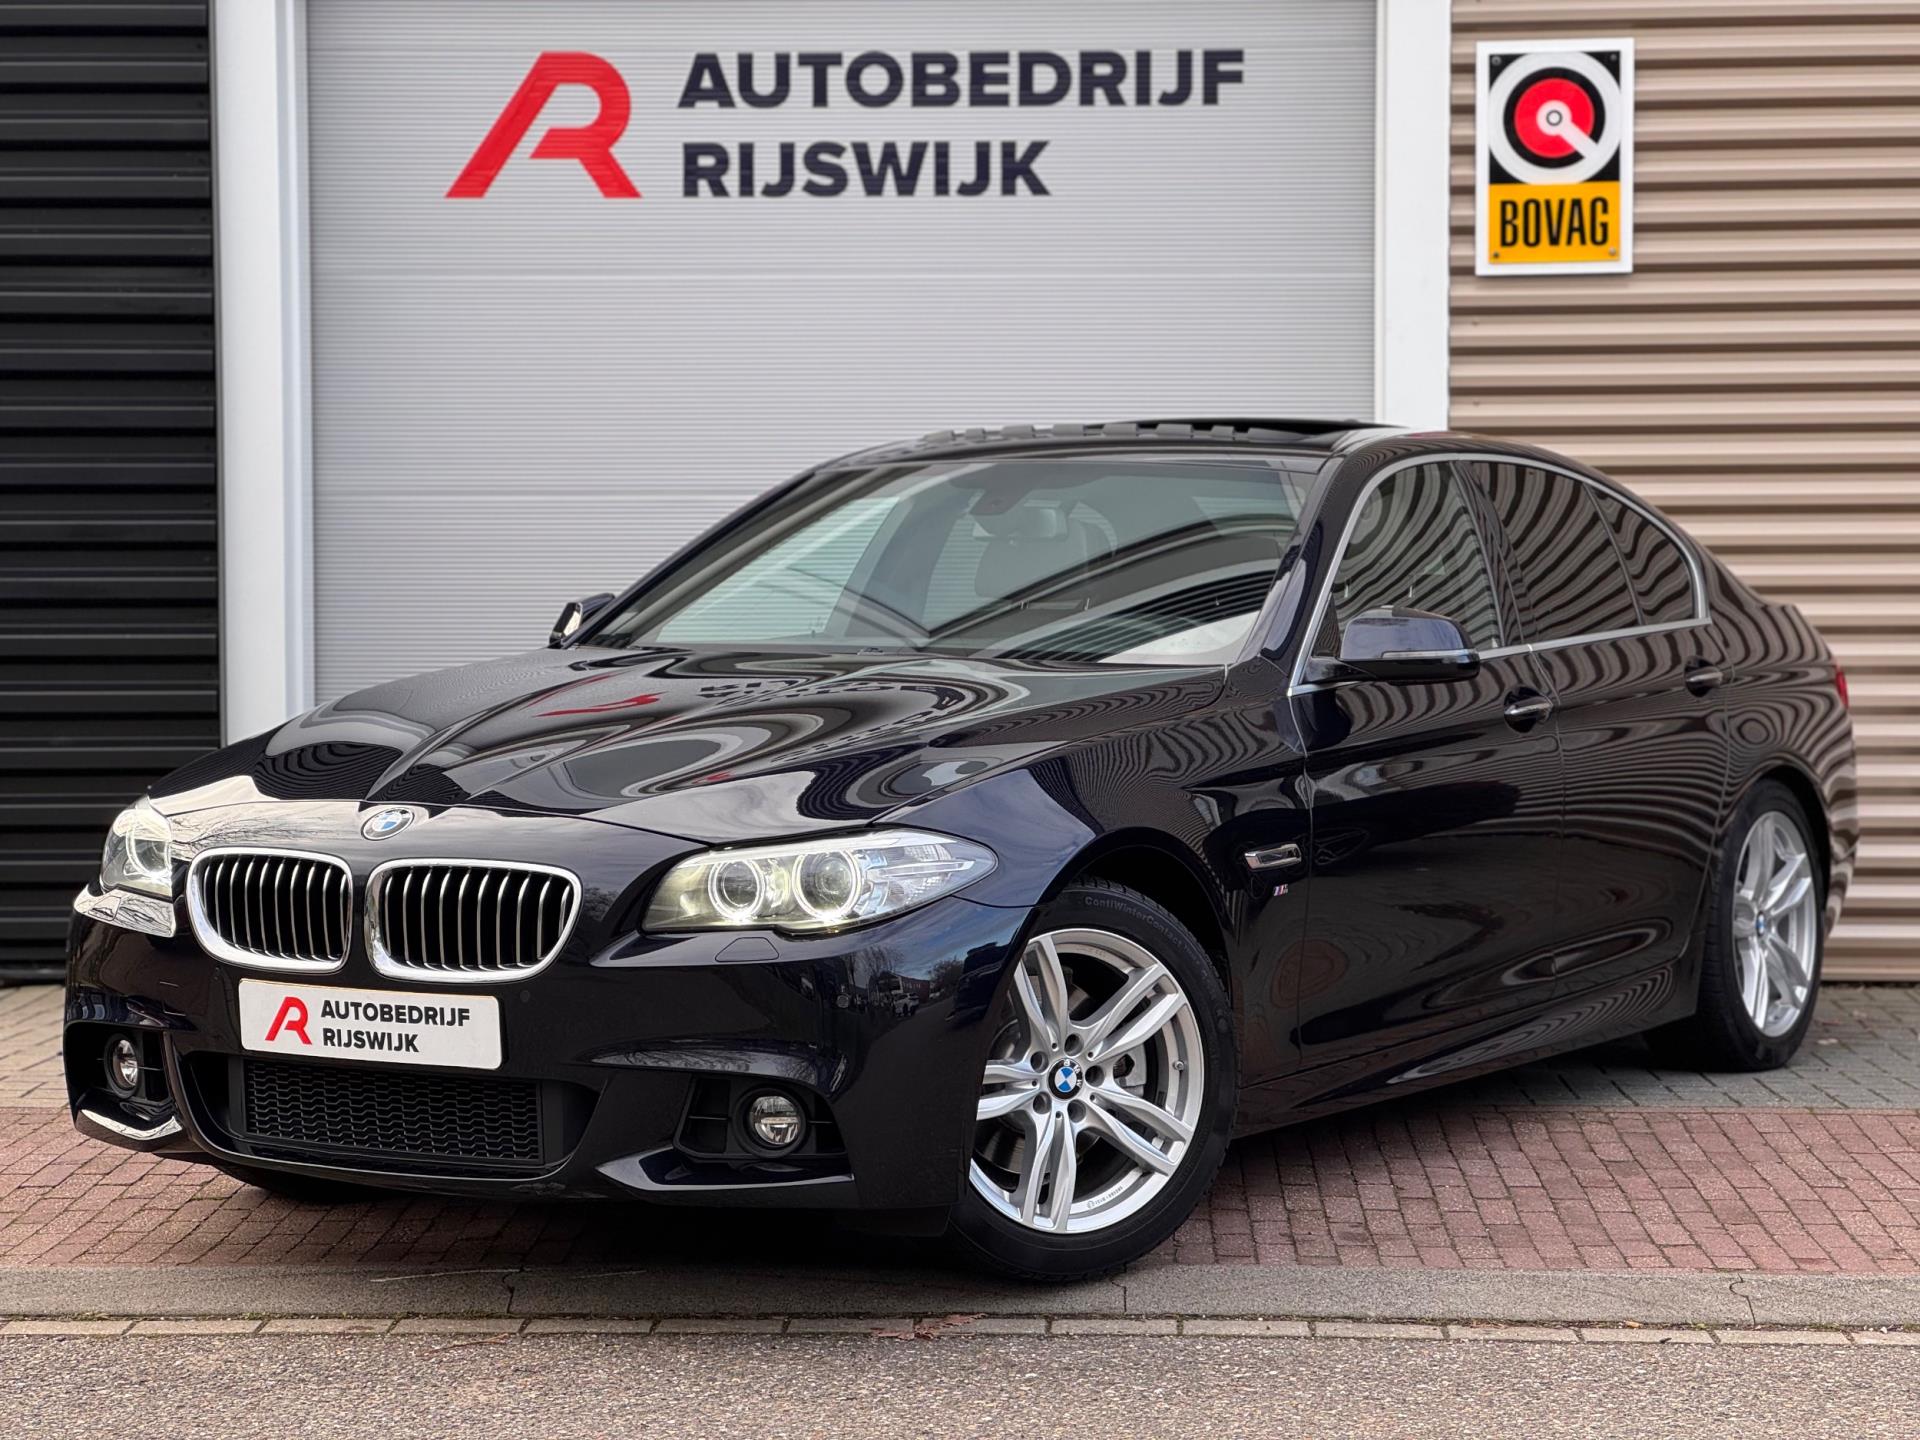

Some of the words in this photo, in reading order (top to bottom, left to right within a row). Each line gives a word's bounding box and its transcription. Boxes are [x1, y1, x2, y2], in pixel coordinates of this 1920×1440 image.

[678, 49, 1244, 109] AUTOBEDRIJF
[683, 140, 1051, 198] RIJSWIJK
[1499, 196, 1610, 248] BOVAG
[320, 999, 470, 1027] AUTOBEDRIJF
[323, 1027, 420, 1053] RIJSWIJK
